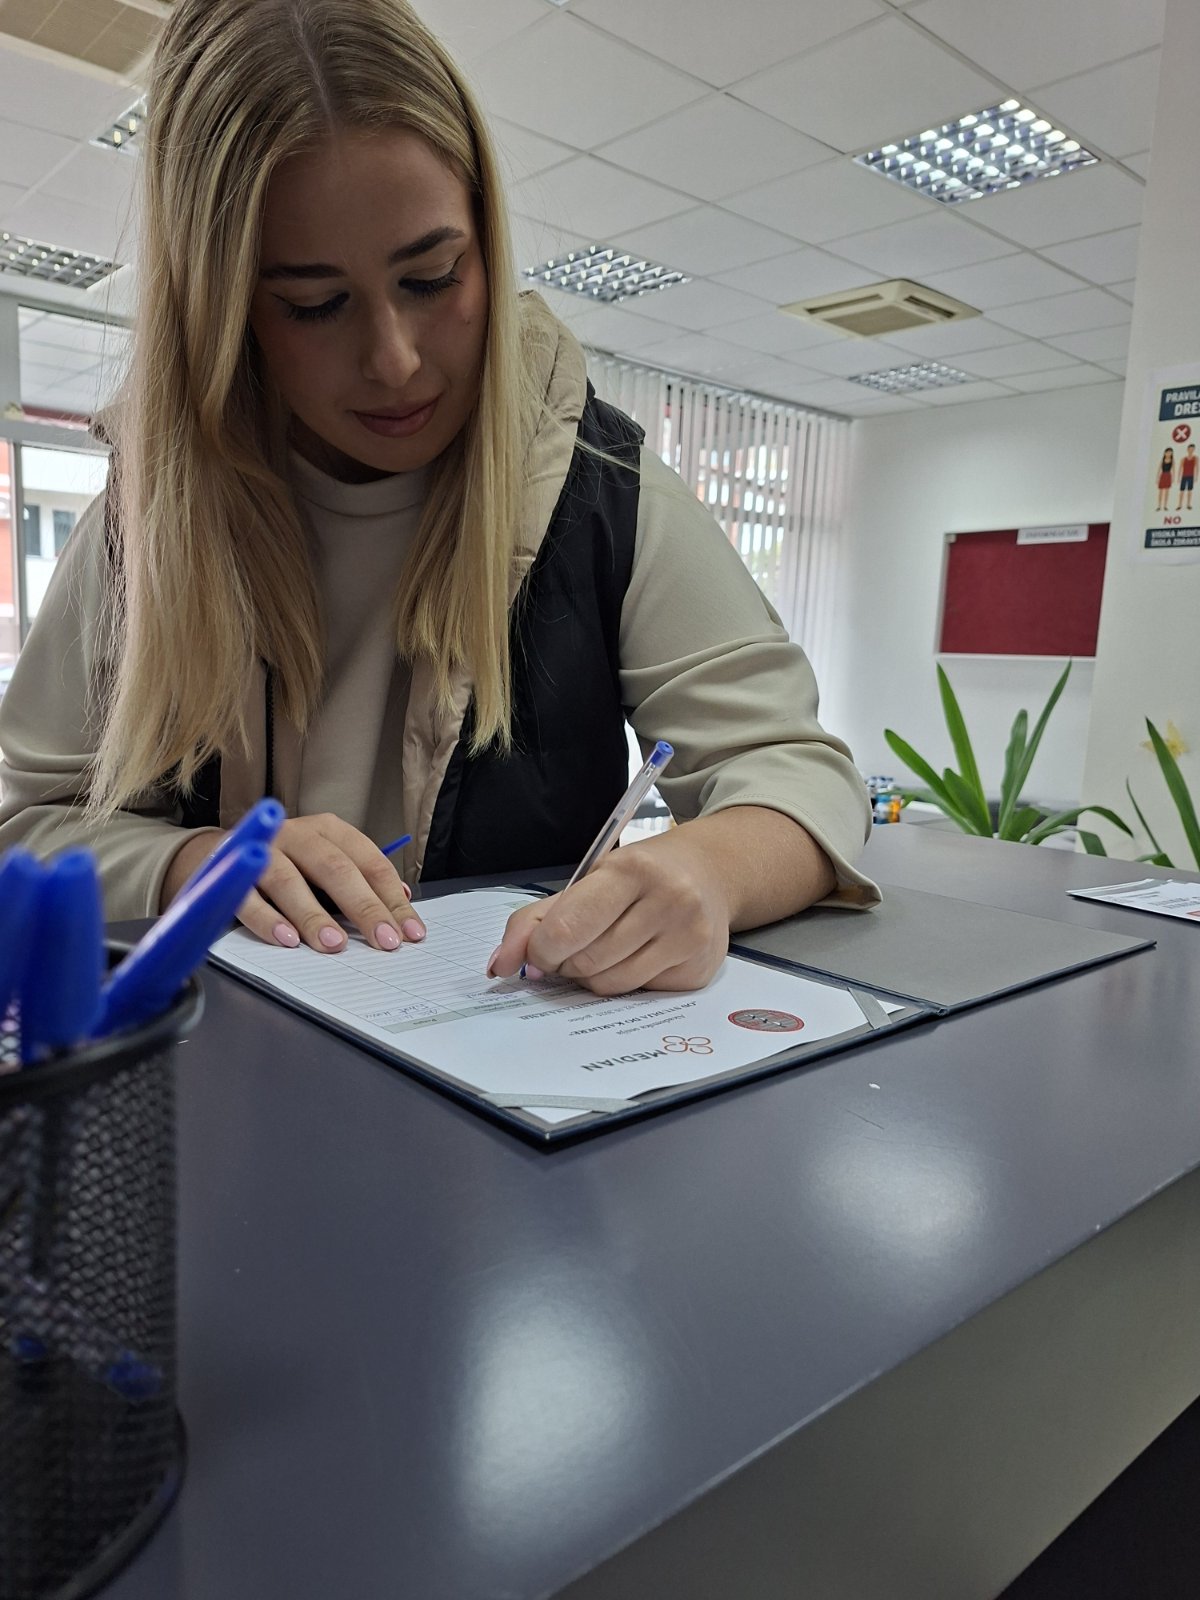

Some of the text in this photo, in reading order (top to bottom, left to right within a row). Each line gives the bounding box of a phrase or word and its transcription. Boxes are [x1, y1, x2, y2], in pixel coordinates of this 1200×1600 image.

[1165, 390, 1200, 403] PRAVIL
[1174, 401, 1200, 417] DRE
[1163, 515, 1182, 525] NO
[580, 1049, 669, 1072] MEDIAN
